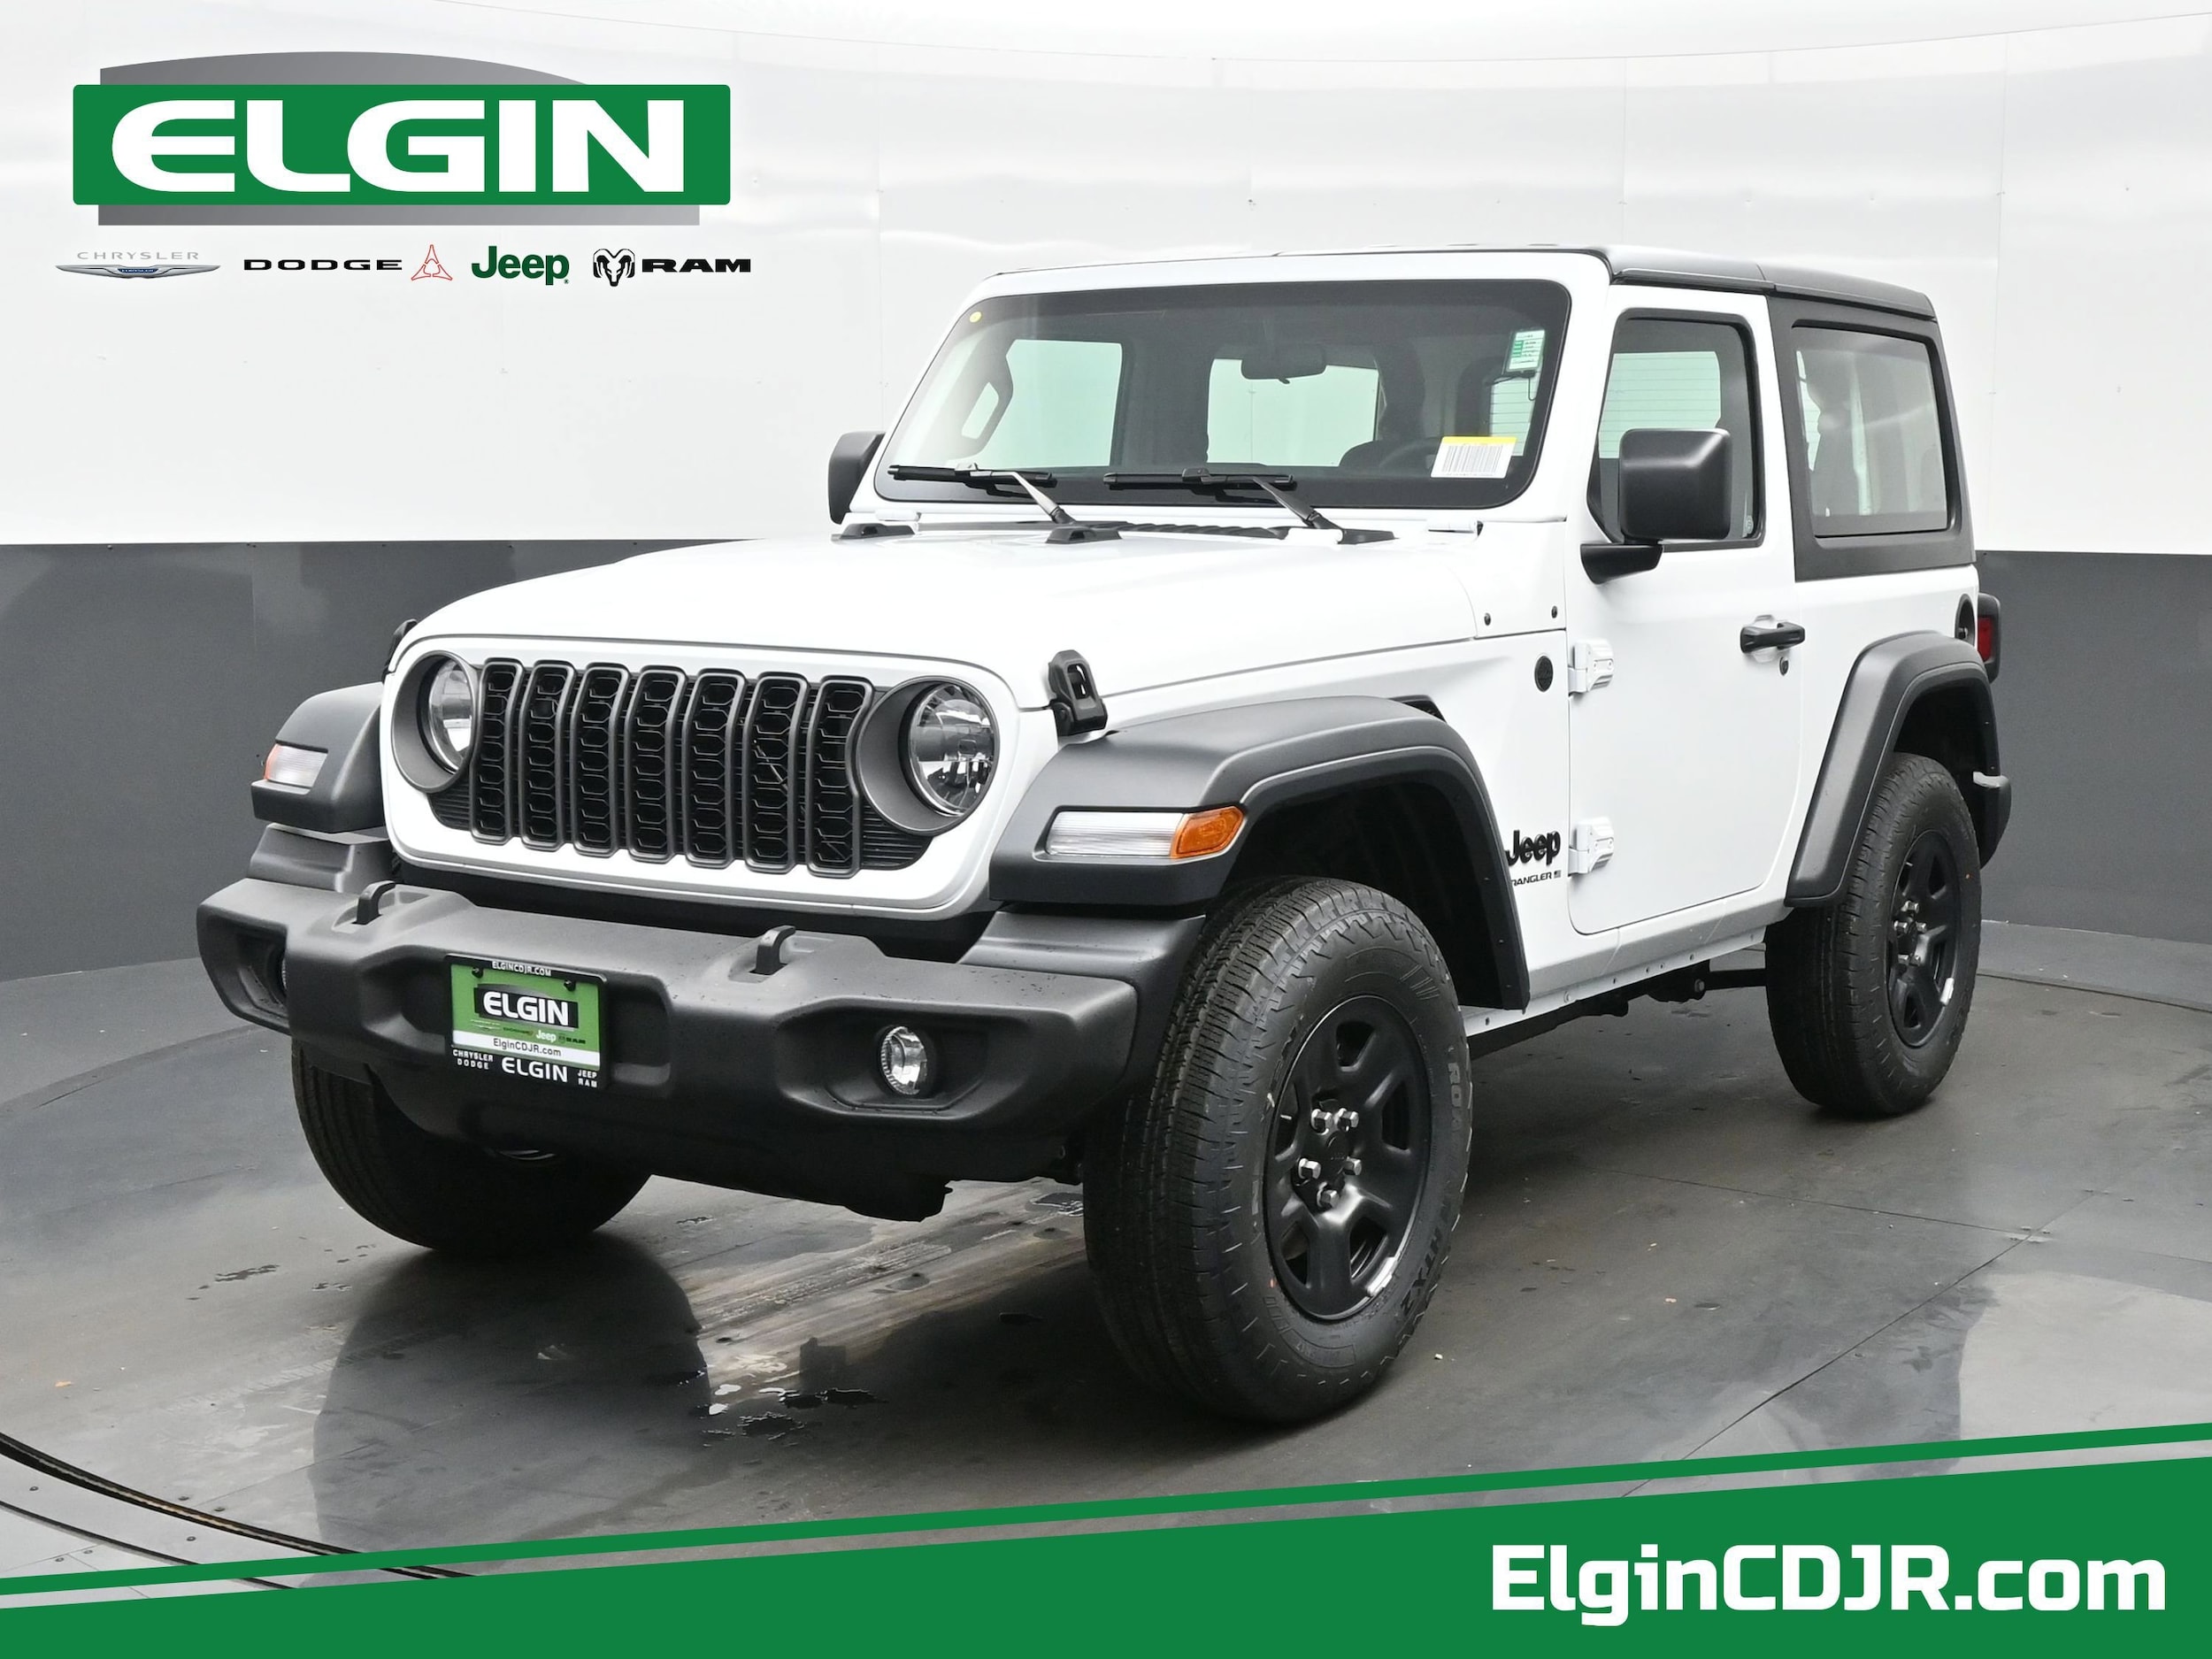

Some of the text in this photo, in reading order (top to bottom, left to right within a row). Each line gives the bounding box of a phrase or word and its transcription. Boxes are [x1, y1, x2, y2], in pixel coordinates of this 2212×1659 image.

[1505, 829, 1561, 866] Jeep
[1511, 872, 1552, 887] RANGLER
[492, 961, 552, 977] ELGINCDJR.COM
[483, 991, 569, 1026] ELGIN
[535, 1030, 557, 1043] Jeep
[493, 1038, 562, 1056] ElginCDJR.com
[452, 1048, 494, 1063] CHRYSLER
[457, 1058, 489, 1070] DODGE
[502, 1057, 568, 1083] ELGIN
[577, 1070, 597, 1079] JEEP
[578, 1079, 597, 1088] RAM
